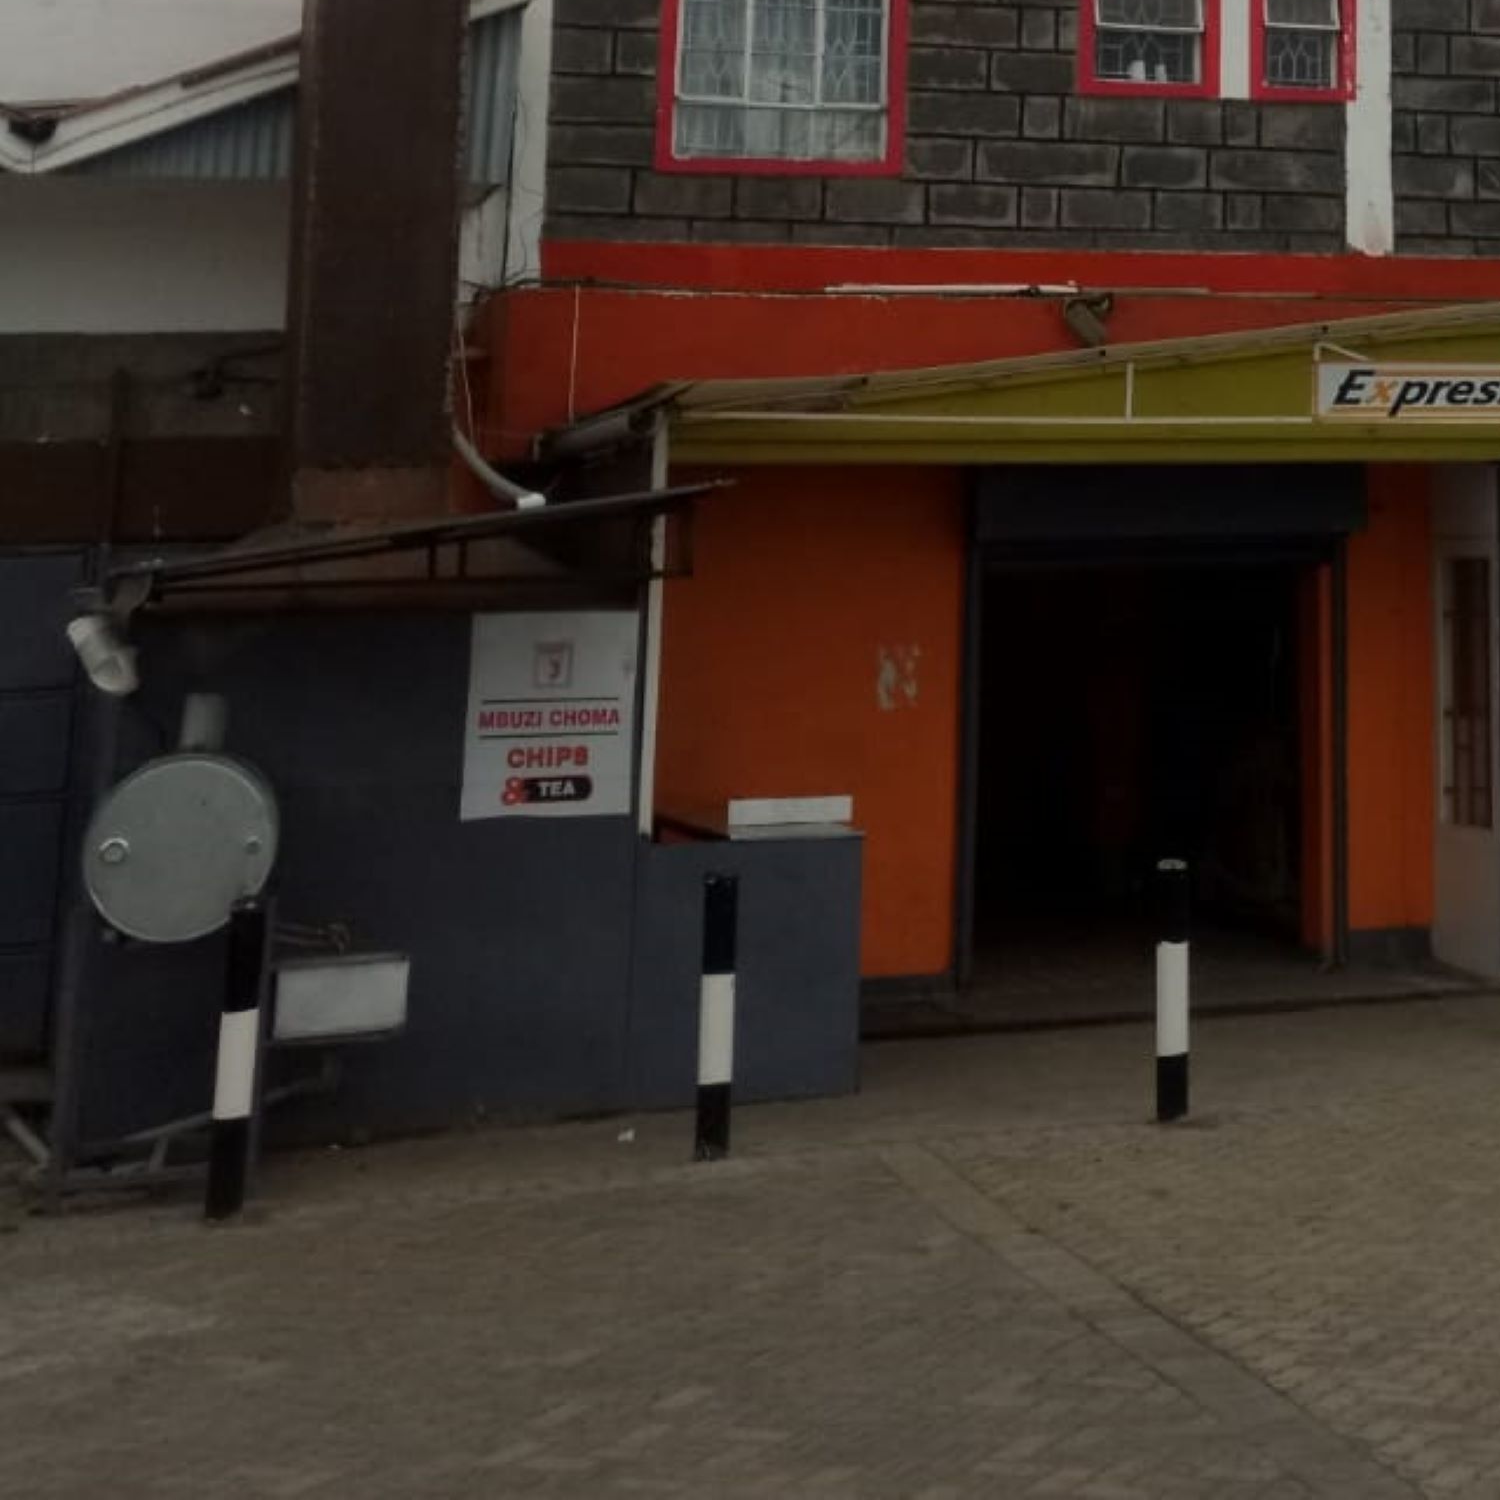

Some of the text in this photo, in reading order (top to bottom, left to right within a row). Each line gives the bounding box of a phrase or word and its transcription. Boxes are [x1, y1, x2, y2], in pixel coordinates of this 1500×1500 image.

[477, 708, 620, 729] MBUZI CHOMA
[507, 745, 589, 768] CHIPS
[501, 776, 575, 806] & TEA
